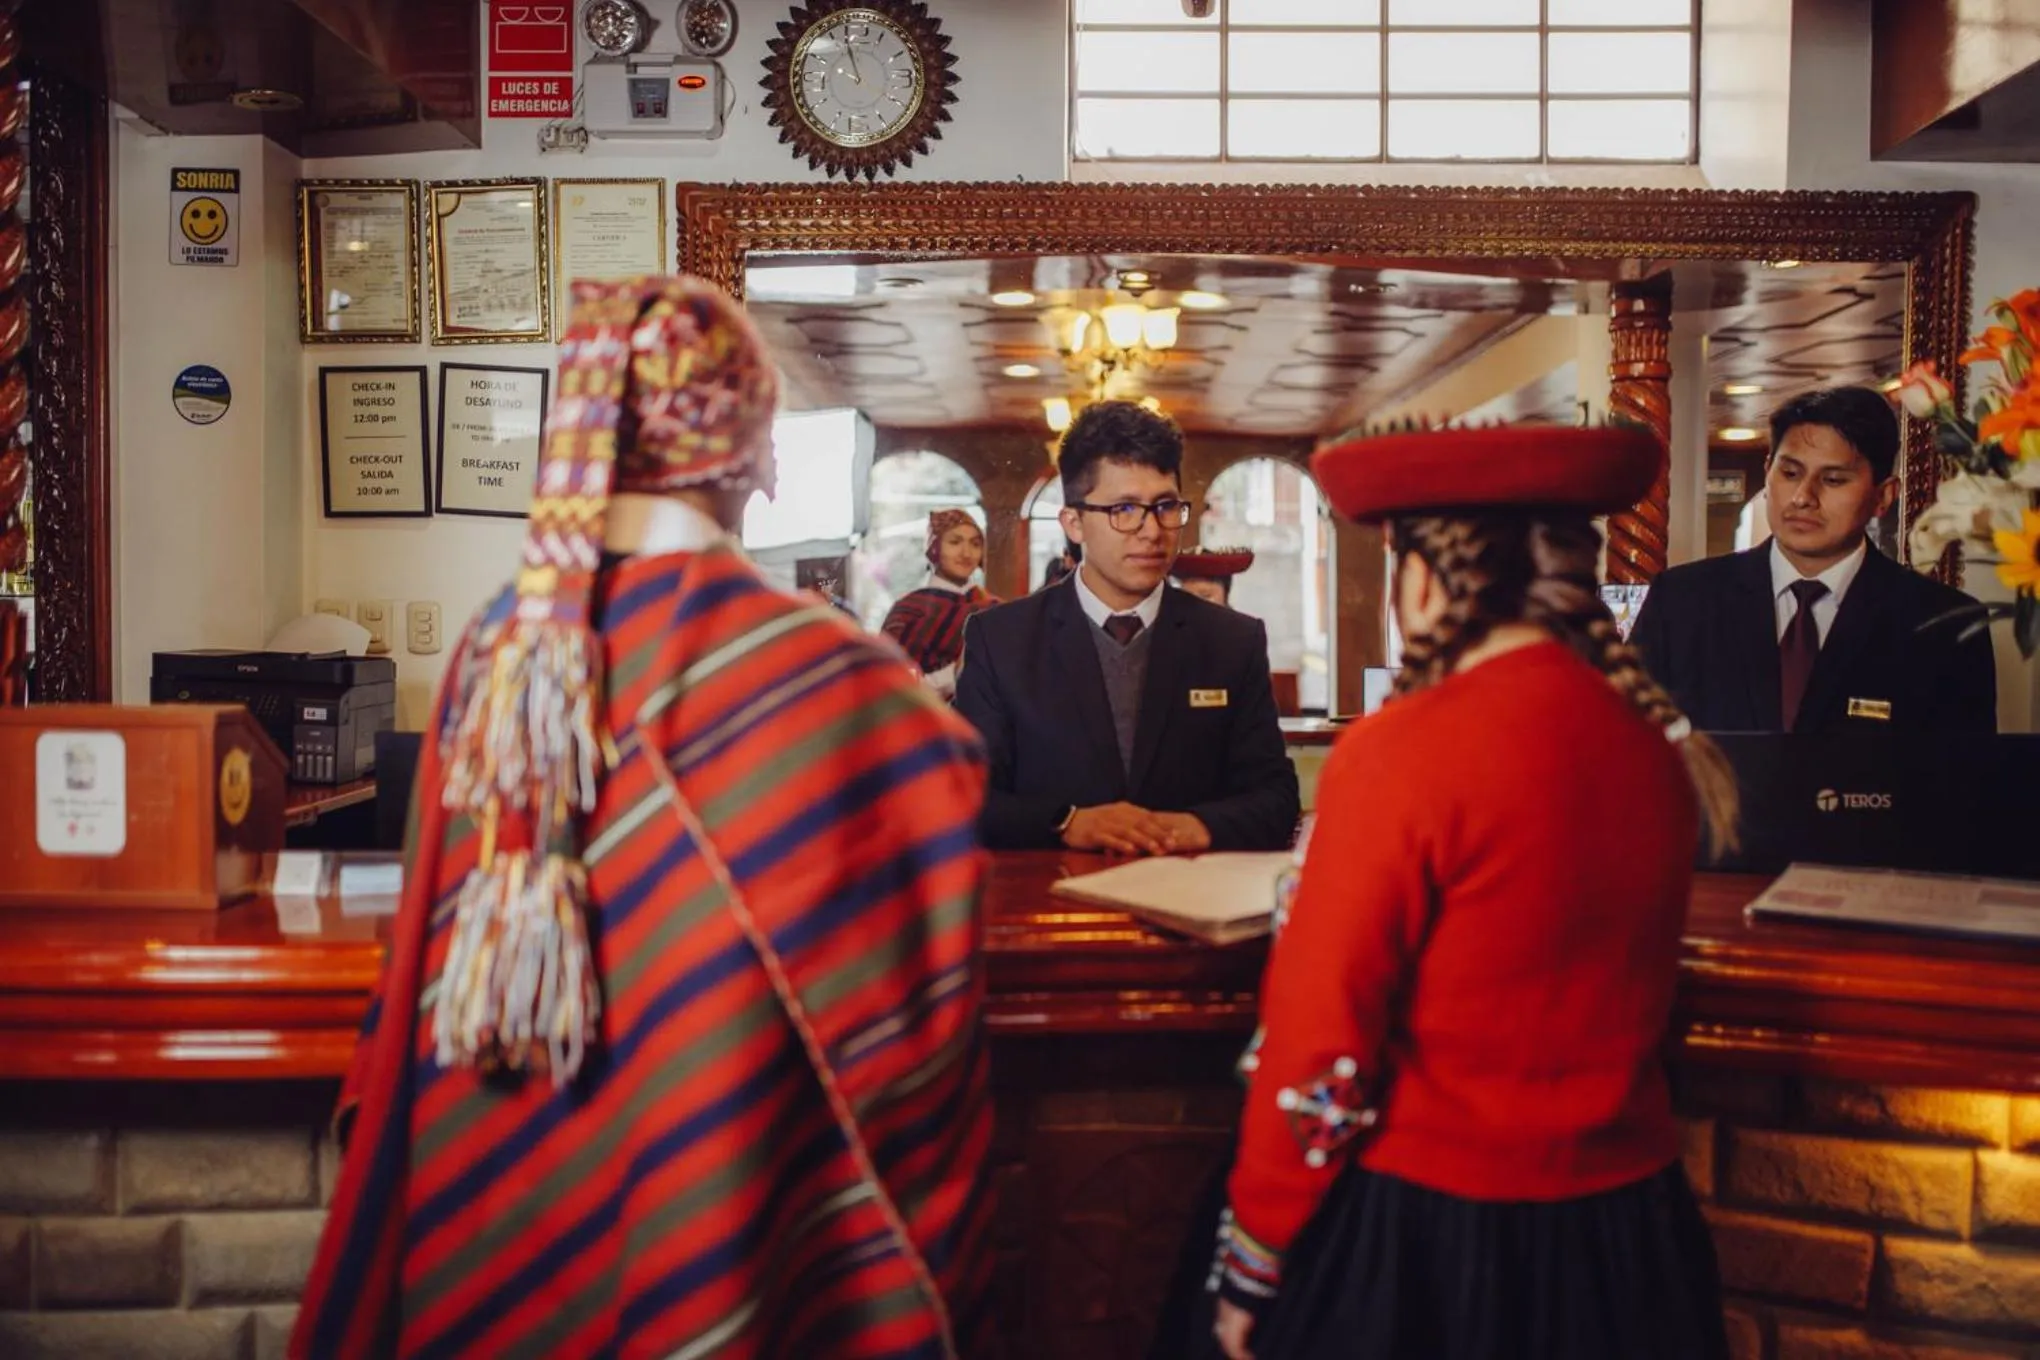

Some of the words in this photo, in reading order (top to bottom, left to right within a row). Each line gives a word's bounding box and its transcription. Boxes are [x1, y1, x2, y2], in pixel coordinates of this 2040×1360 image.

[501, 82, 540, 95] LUCES
[543, 82, 559, 95] DE
[490, 99, 570, 112] EMERGENCIA
[176, 171, 235, 189] SONRIA
[351, 382, 396, 392] CHECK-IN
[470, 380, 501, 391] HORA
[353, 398, 396, 407] INGRESO
[465, 396, 522, 409] DESAYUNO
[353, 414, 379, 423] 12:00
[381, 415, 396, 424] pm
[349, 455, 403, 465] CHECK-OUT
[461, 458, 521, 472] BREAKFAST
[360, 470, 394, 479] SALIDA
[478, 476, 504, 487] TIME
[357, 487, 382, 496] 10:00
[385, 487, 400, 496] am
[1843, 793, 1892, 809] TEROS
